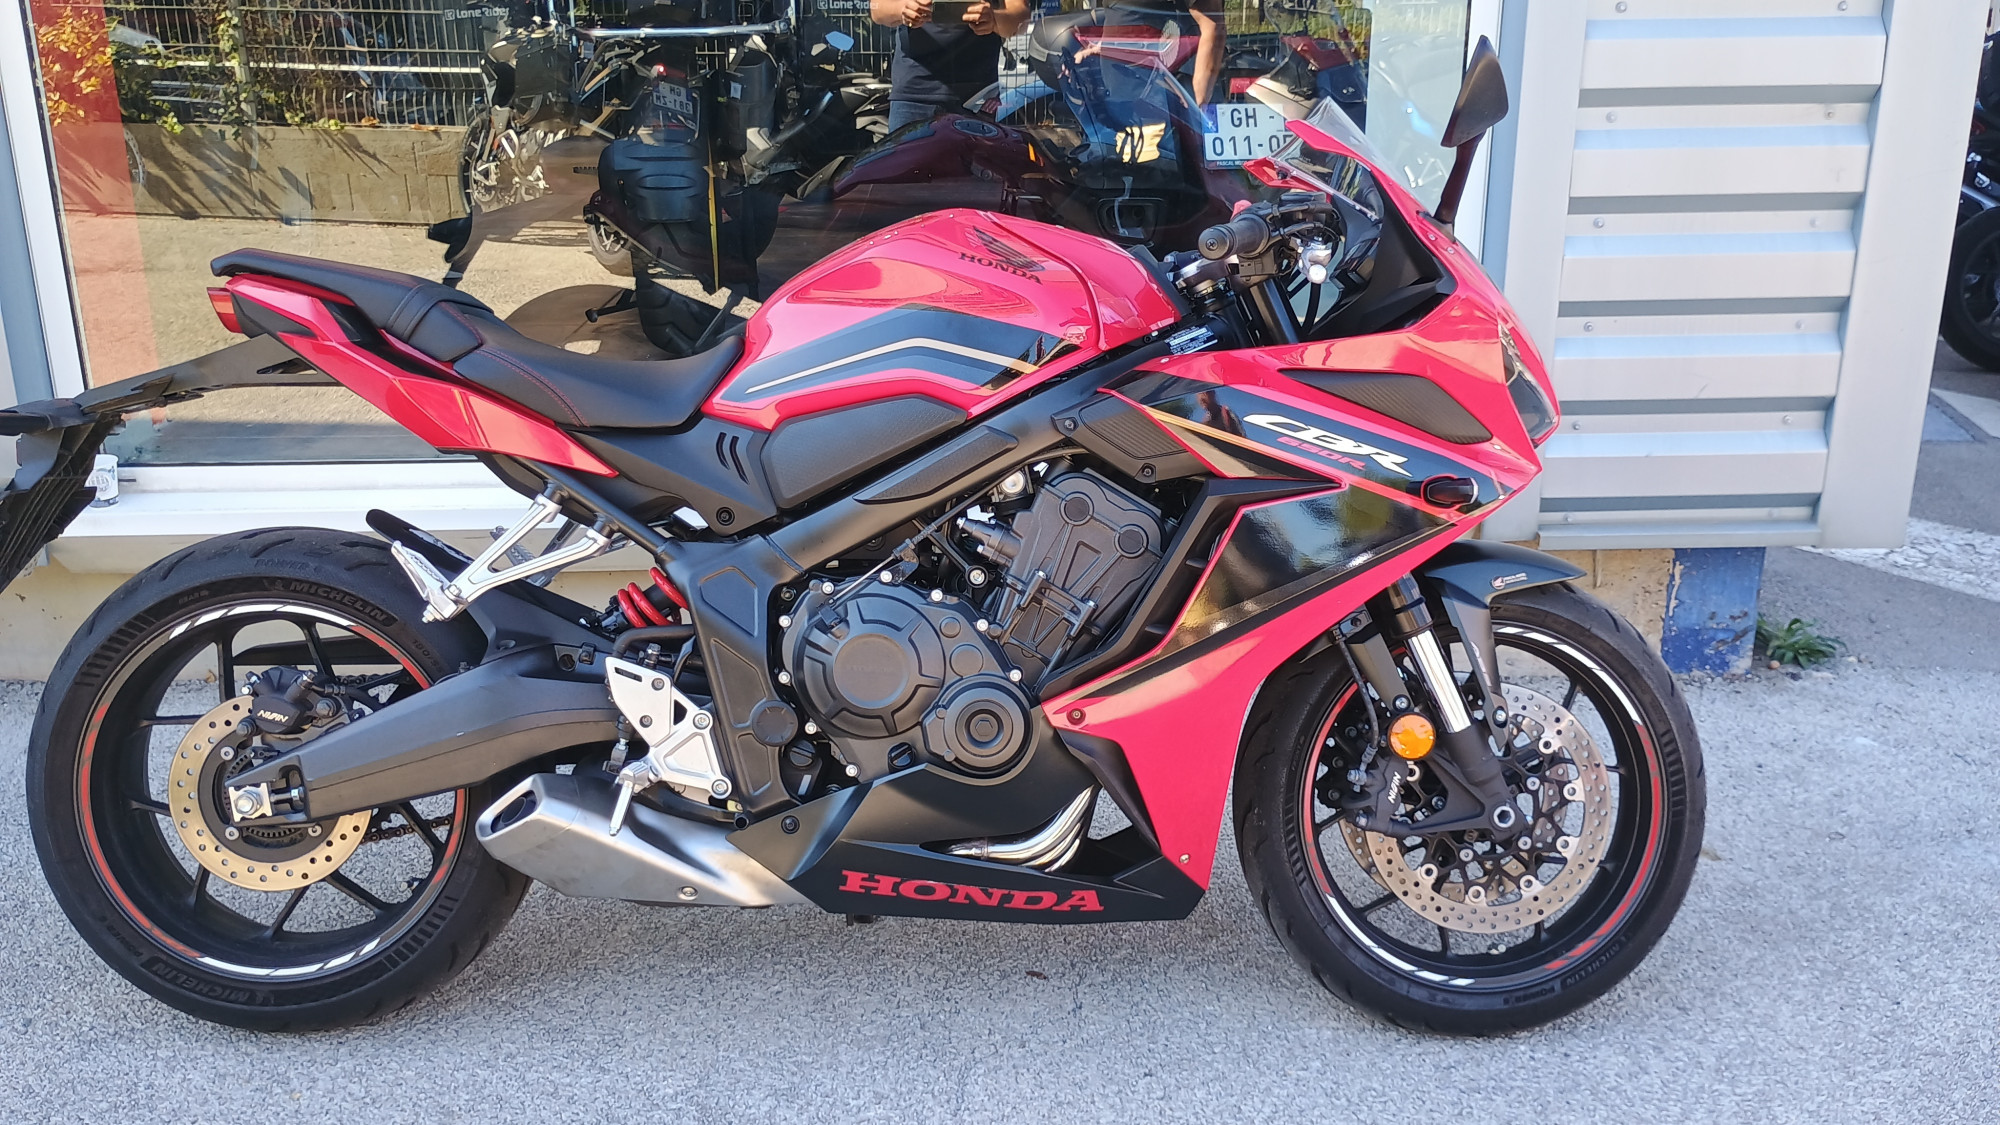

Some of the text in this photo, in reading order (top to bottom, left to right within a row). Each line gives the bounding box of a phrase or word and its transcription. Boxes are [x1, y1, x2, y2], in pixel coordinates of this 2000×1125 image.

[1230, 107, 1258, 128] GH
[958, 252, 1043, 285] HONDA
[1242, 414, 1414, 478] CBR
[1276, 436, 1368, 472] 650R
[289, 581, 389, 623] MICHELIN
[838, 869, 1105, 912] HONDA
[151, 961, 251, 1004] MICHELIN
[1565, 945, 1621, 987] MICHELIN
